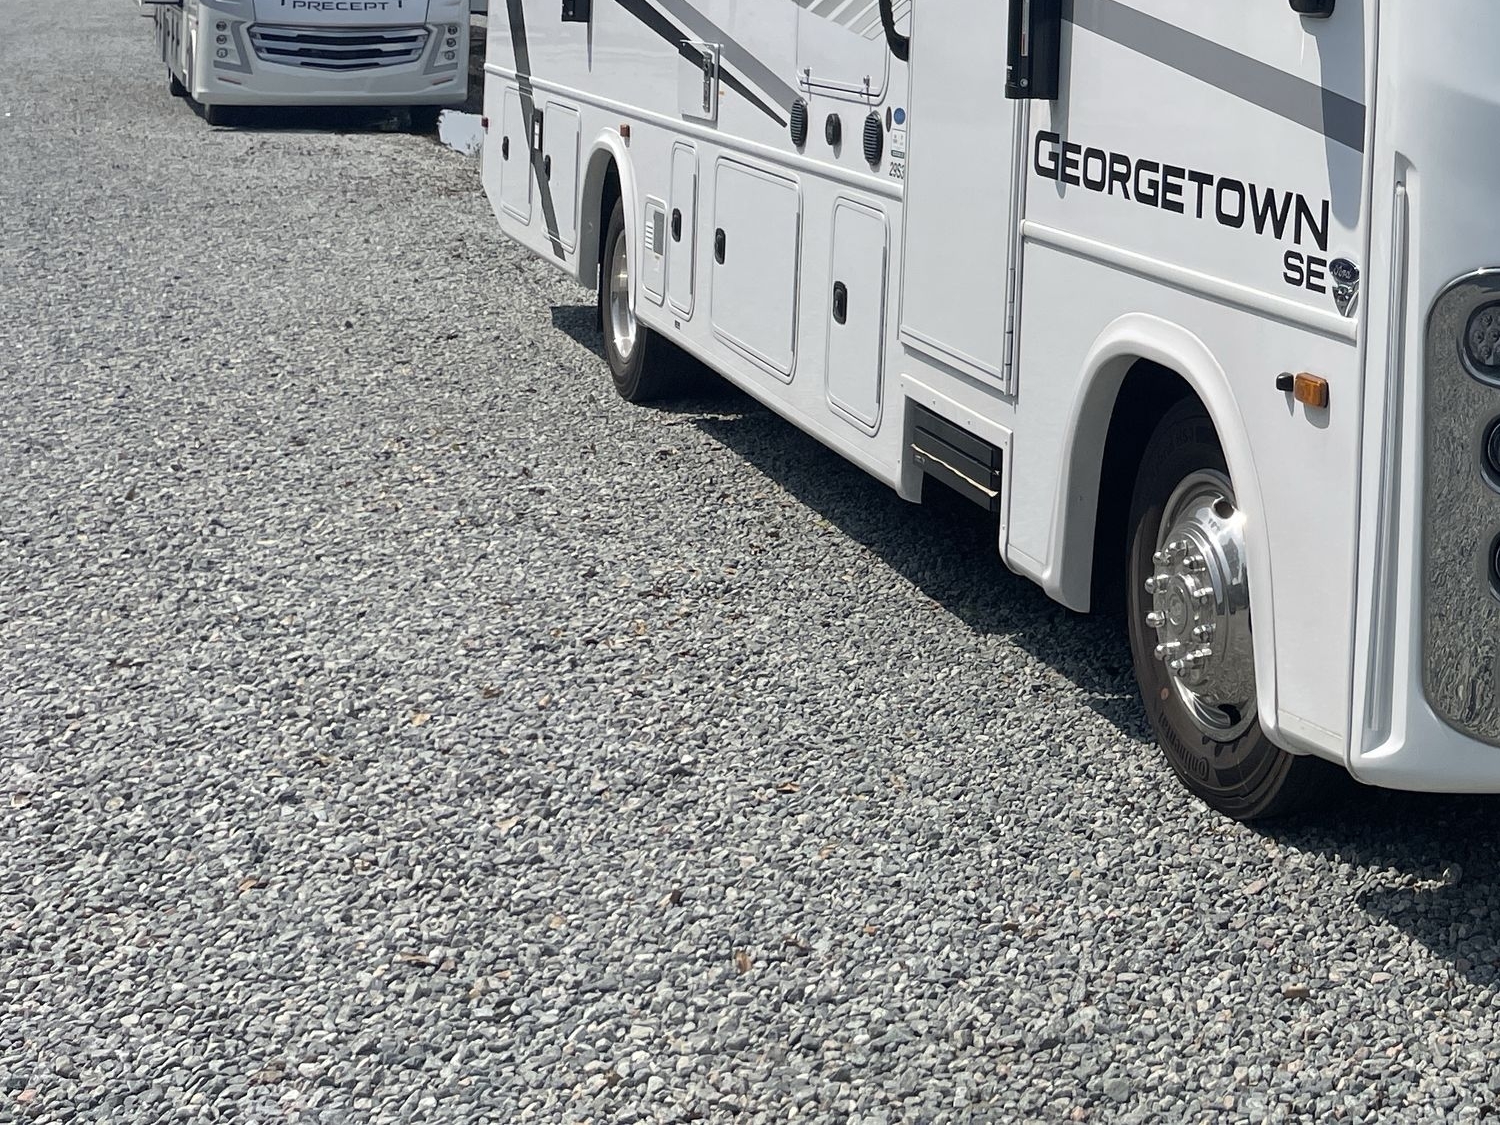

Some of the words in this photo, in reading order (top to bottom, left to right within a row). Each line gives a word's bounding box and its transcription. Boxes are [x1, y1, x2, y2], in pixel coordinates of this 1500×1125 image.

[293, 0, 389, 12] PRECEPT
[1034, 129, 1330, 252] GEORGETOWN
[1283, 250, 1328, 295] SE
